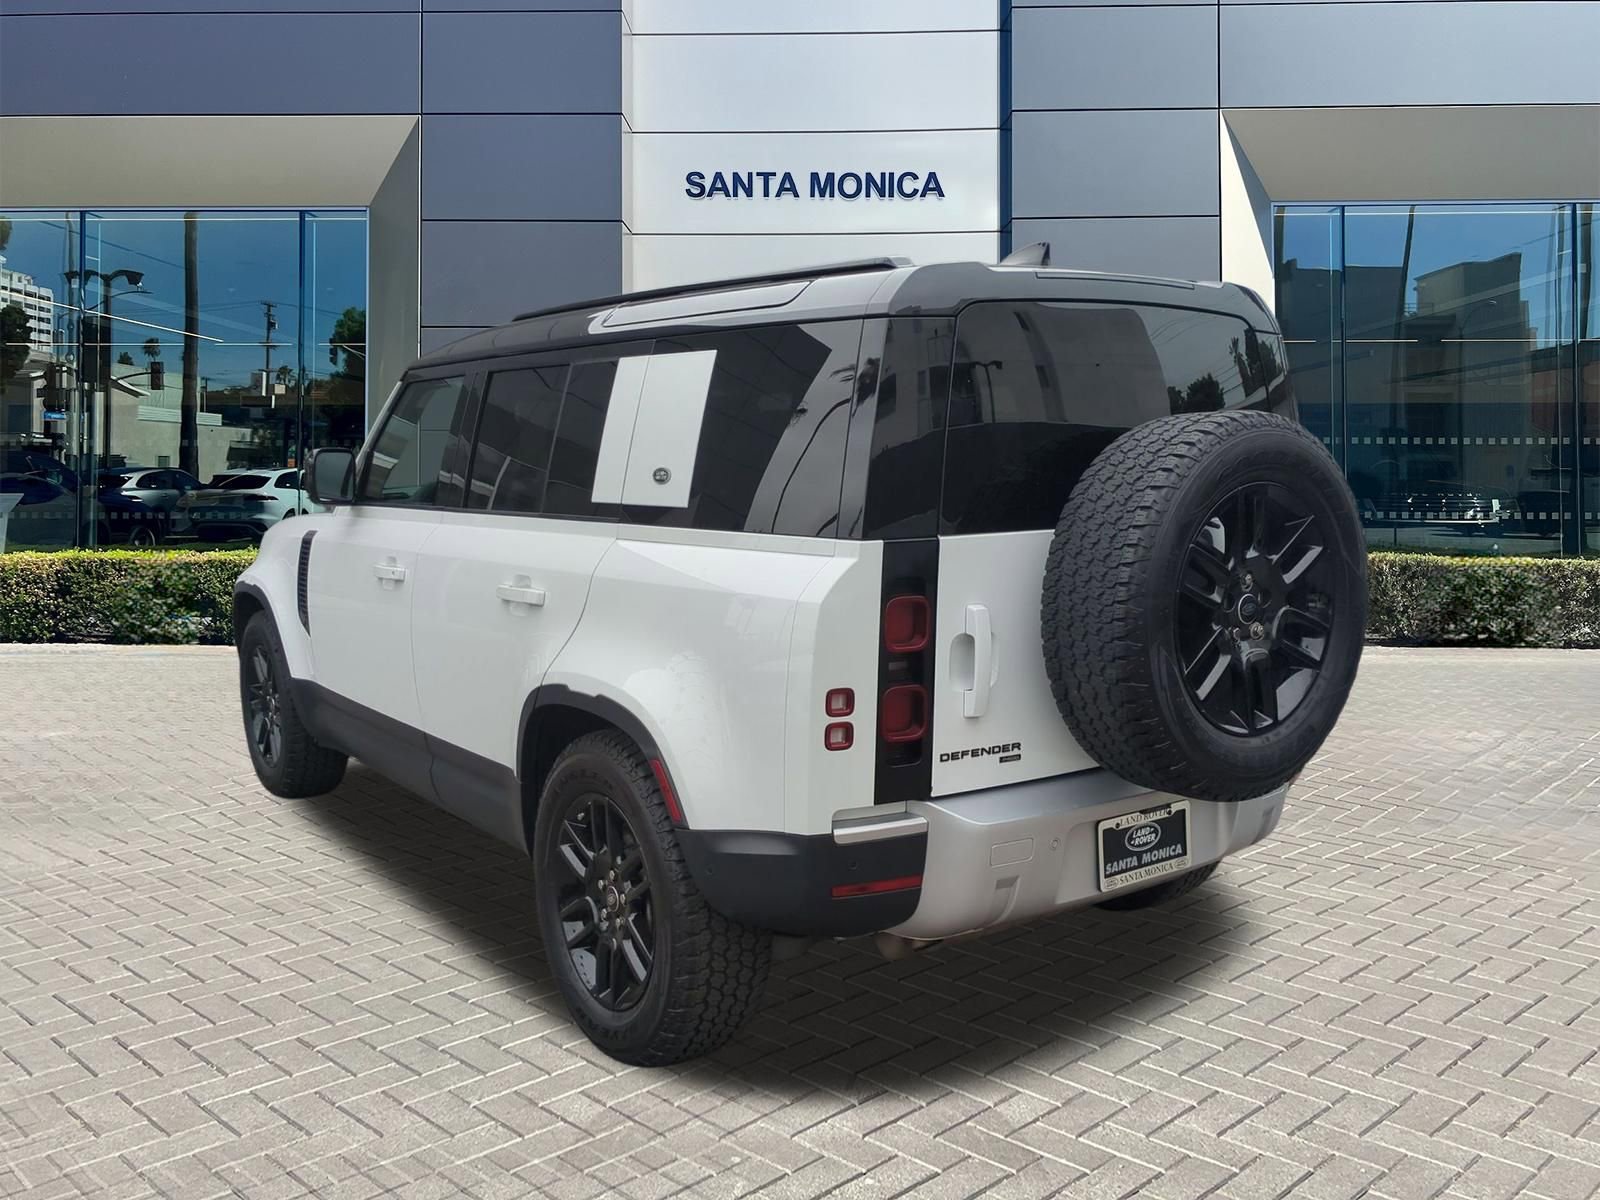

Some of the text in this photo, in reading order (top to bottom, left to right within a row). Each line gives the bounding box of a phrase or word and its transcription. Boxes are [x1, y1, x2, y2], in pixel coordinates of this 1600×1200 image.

[685, 171, 945, 199] SANTA MONICA
[939, 742, 1022, 763] DEFENDER
[1120, 814, 1142, 827] LAND
[1133, 827, 1151, 838] LAND
[1134, 833, 1156, 846] ROVER
[1105, 855, 1138, 874] SANTA
[1141, 844, 1182, 864] MONICA
[1119, 872, 1143, 885] SANTA
[1144, 863, 1174, 878] MONICA
